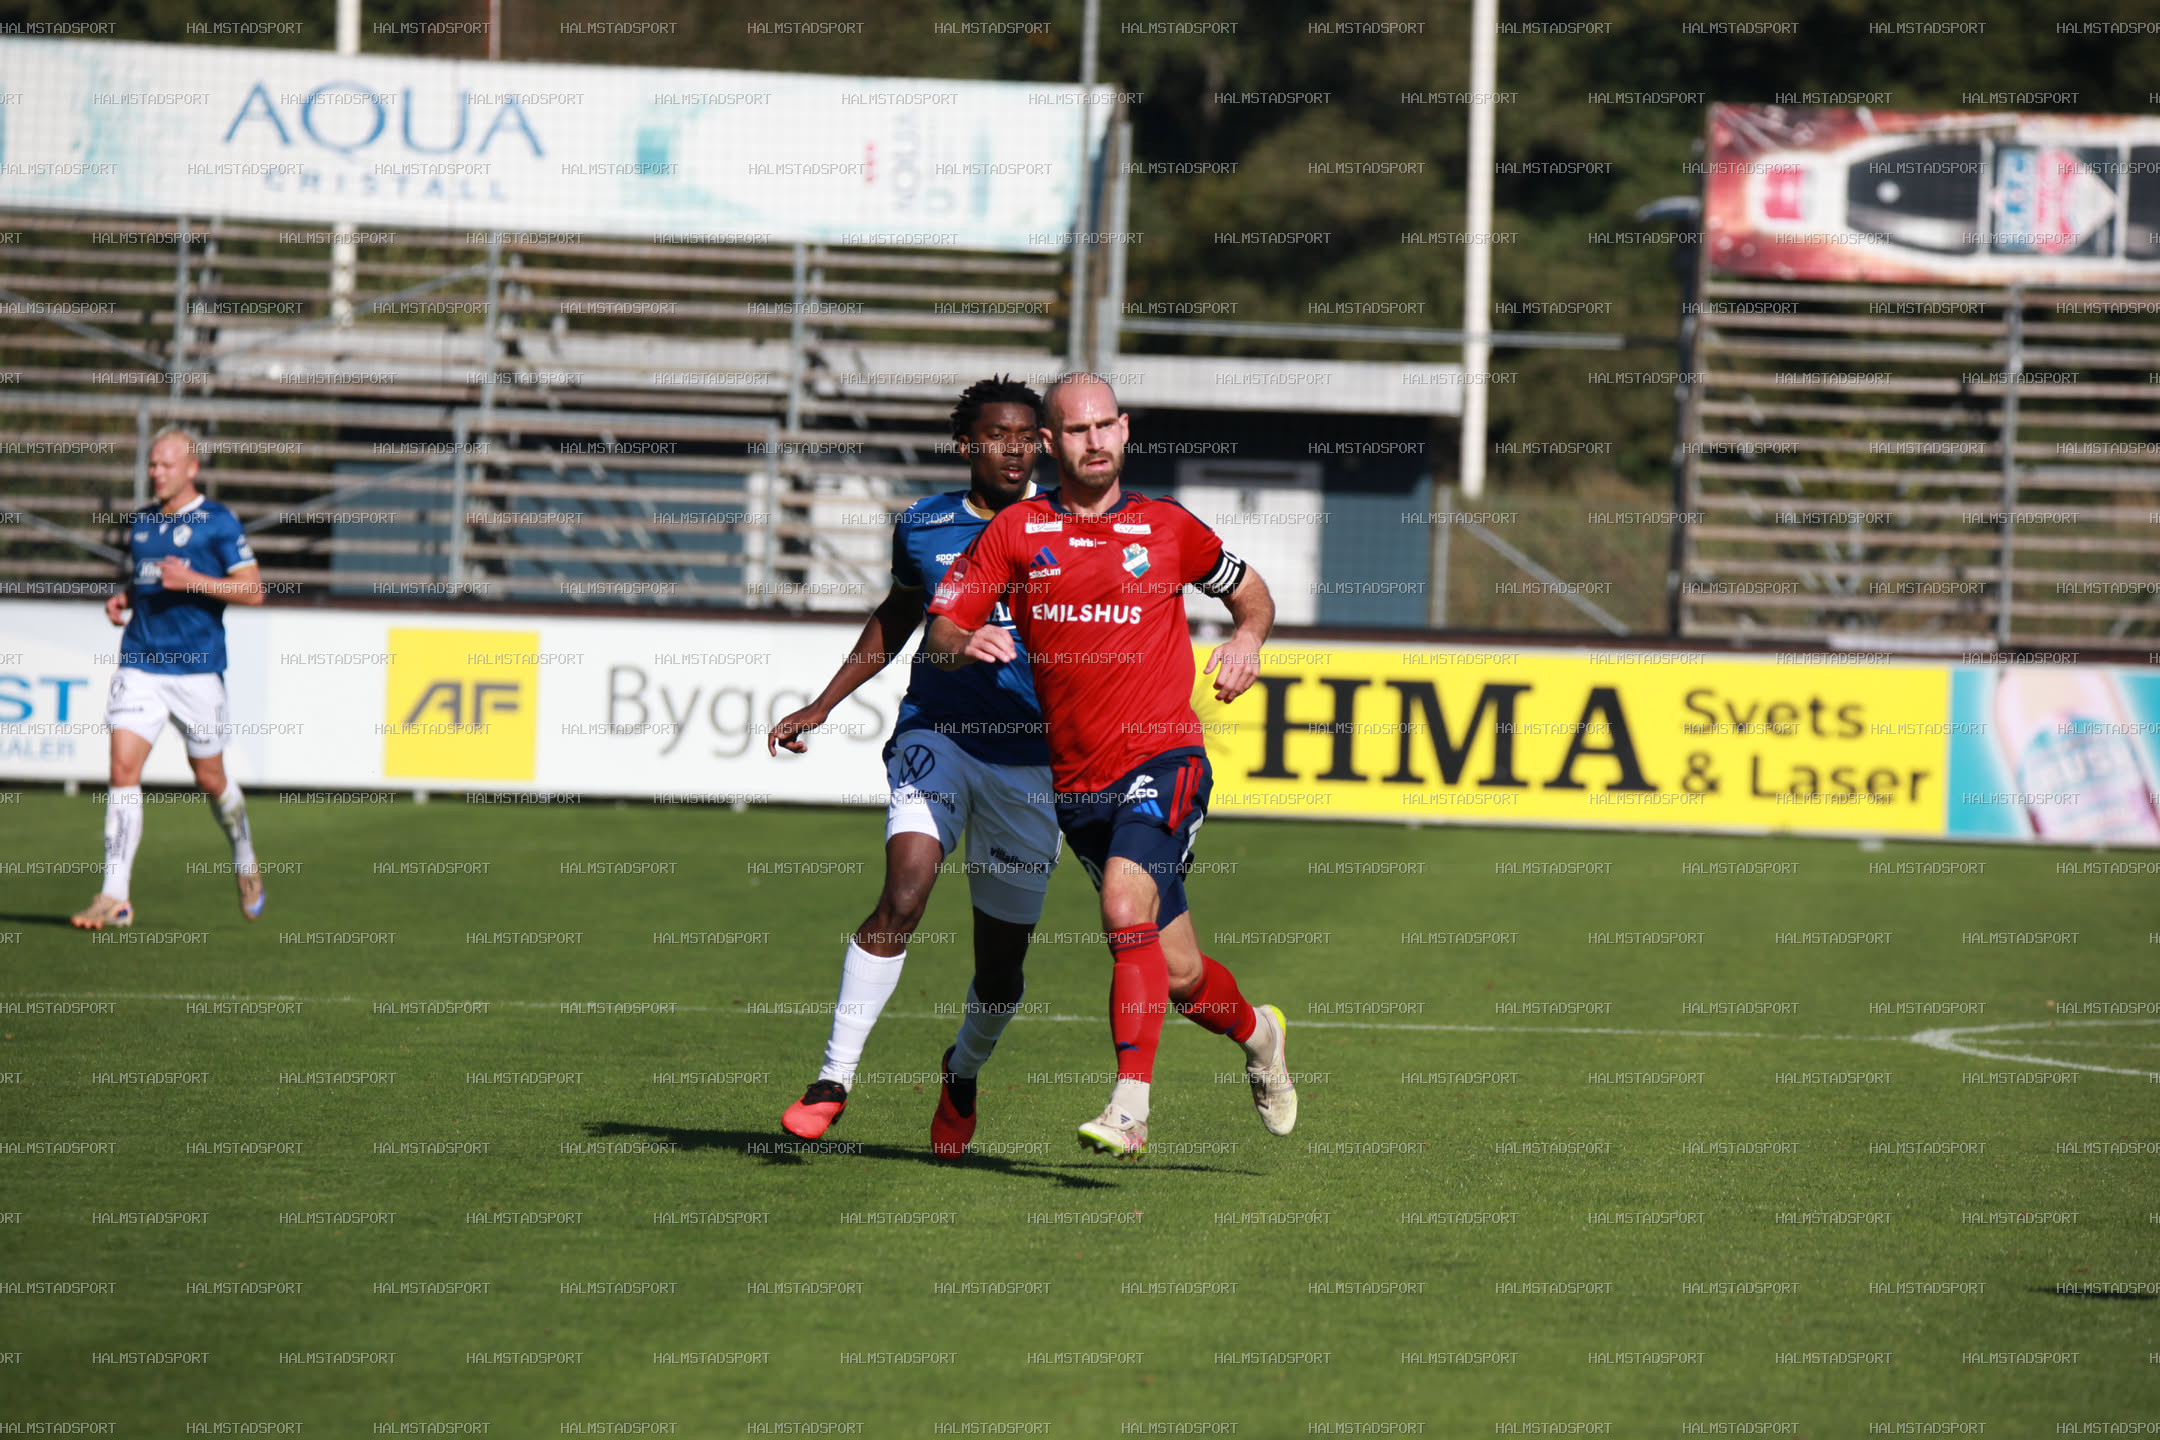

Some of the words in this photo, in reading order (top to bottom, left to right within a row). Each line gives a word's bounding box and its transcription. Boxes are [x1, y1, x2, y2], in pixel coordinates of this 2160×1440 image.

[222, 80, 546, 157] AQUA
[1032, 603, 1142, 624] EMILSHUS
[402, 680, 519, 728] AF
[1683, 688, 1865, 740] Svets
[1246, 675, 1660, 793] HMA
[1681, 752, 1719, 796] &
[1749, 754, 1931, 804] Laser
